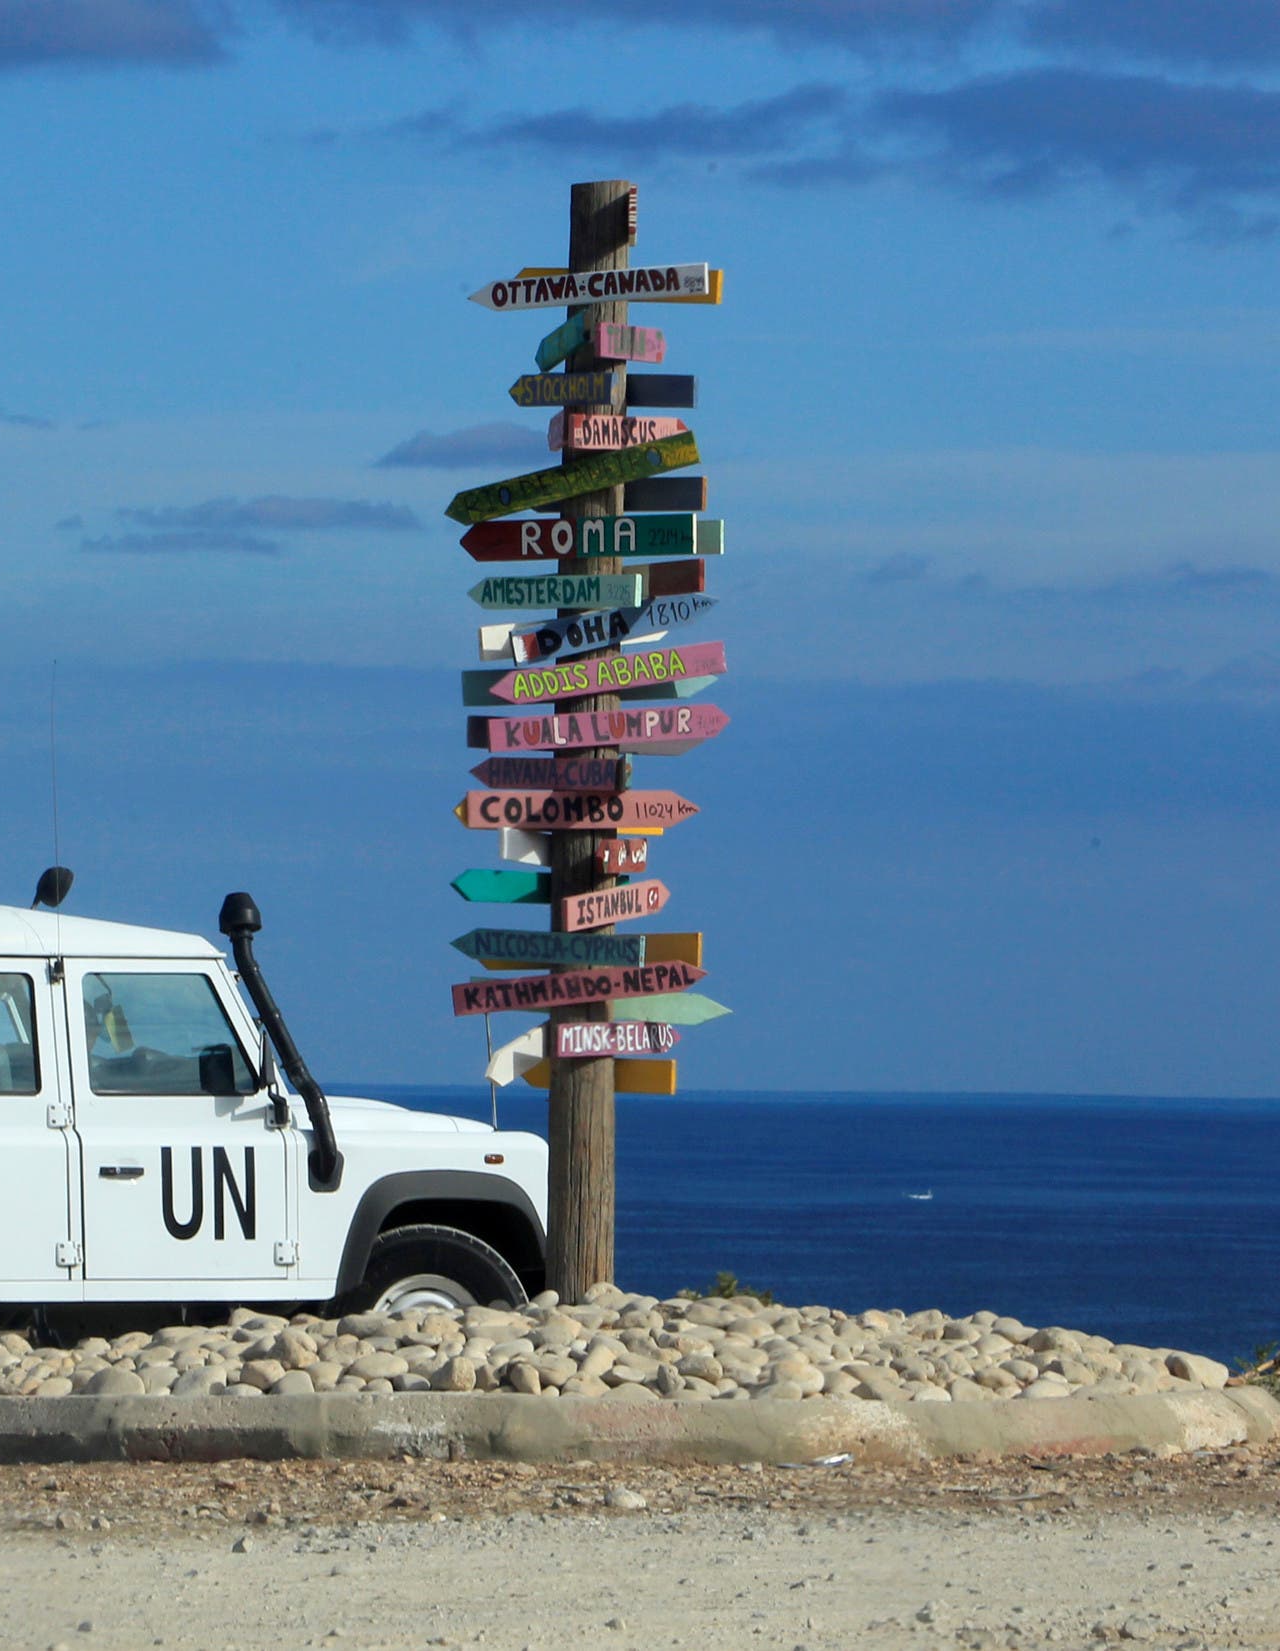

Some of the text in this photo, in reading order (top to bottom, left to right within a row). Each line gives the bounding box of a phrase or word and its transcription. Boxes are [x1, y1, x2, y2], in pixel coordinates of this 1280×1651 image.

[524, 375, 605, 402] STOCKHOLM
[582, 416, 656, 446] DAMASCUS
[521, 518, 636, 556] ROMA
[536, 597, 711, 655] DOHA 1810 km
[513, 663, 589, 699] ADDIS
[597, 649, 687, 687] ABABA
[505, 716, 582, 748] KUALA
[593, 707, 692, 742] LUMPUR
[480, 795, 698, 823] COLOMBO 11024 km
[577, 888, 642, 925] ISTANBUL
[161, 1145, 256, 1241] UN
